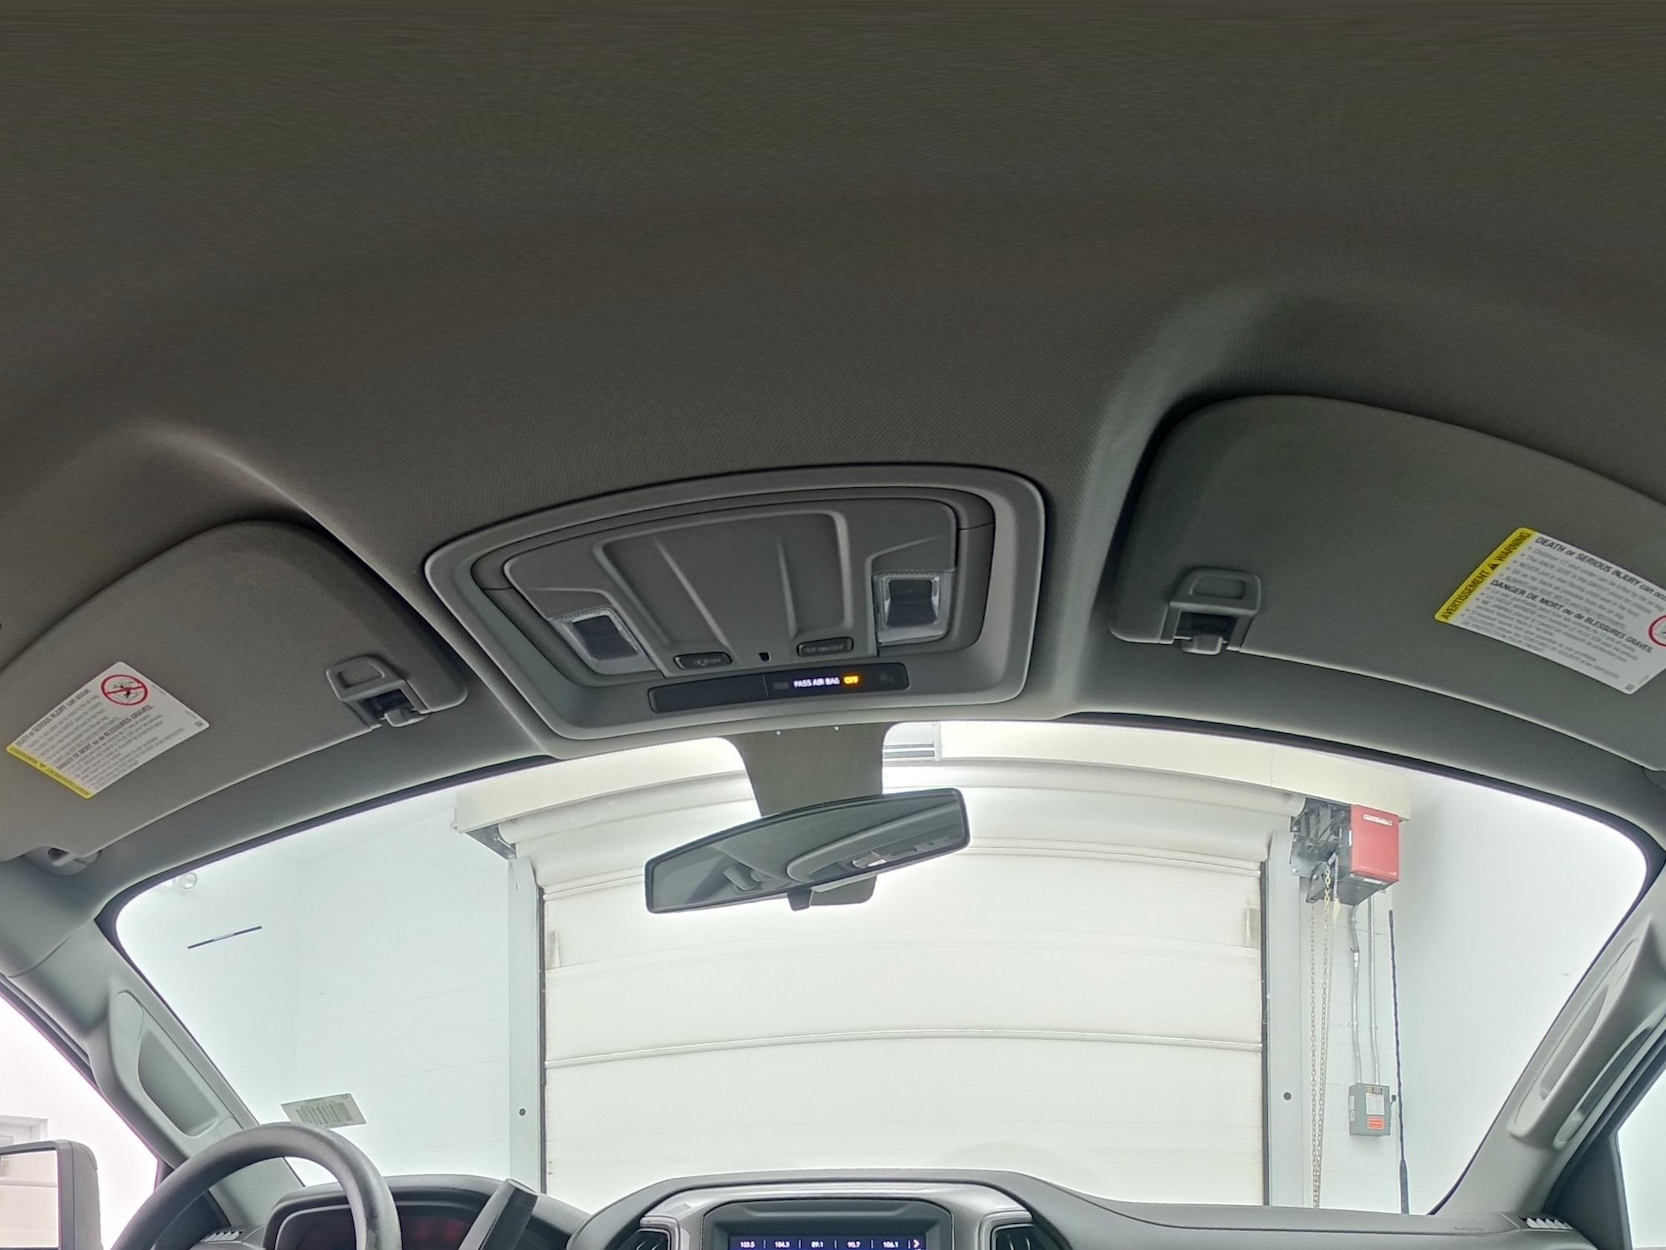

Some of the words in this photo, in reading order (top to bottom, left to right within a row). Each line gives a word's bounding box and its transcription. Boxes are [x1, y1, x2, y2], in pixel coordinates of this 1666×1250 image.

[1498, 531, 1531, 563] WARNING
[1534, 536, 1565, 552] DEATH
[1565, 548, 1576, 556] or
[1575, 552, 1612, 573] SERIOUS
[1610, 568, 1641, 586] INJURY
[1441, 570, 1490, 620] AVERTISSEMENT
[1490, 579, 1526, 597] DANGER
[1526, 592, 1539, 601] DE
[1539, 597, 1564, 611] MORT
[1562, 608, 1573, 616] ou
[1573, 612, 1584, 620] de
[1584, 616, 1627, 639] BLESSURES
[793, 679, 813, 688] PASS
[813, 677, 824, 687] AIR
[825, 677, 840, 686] BAG
